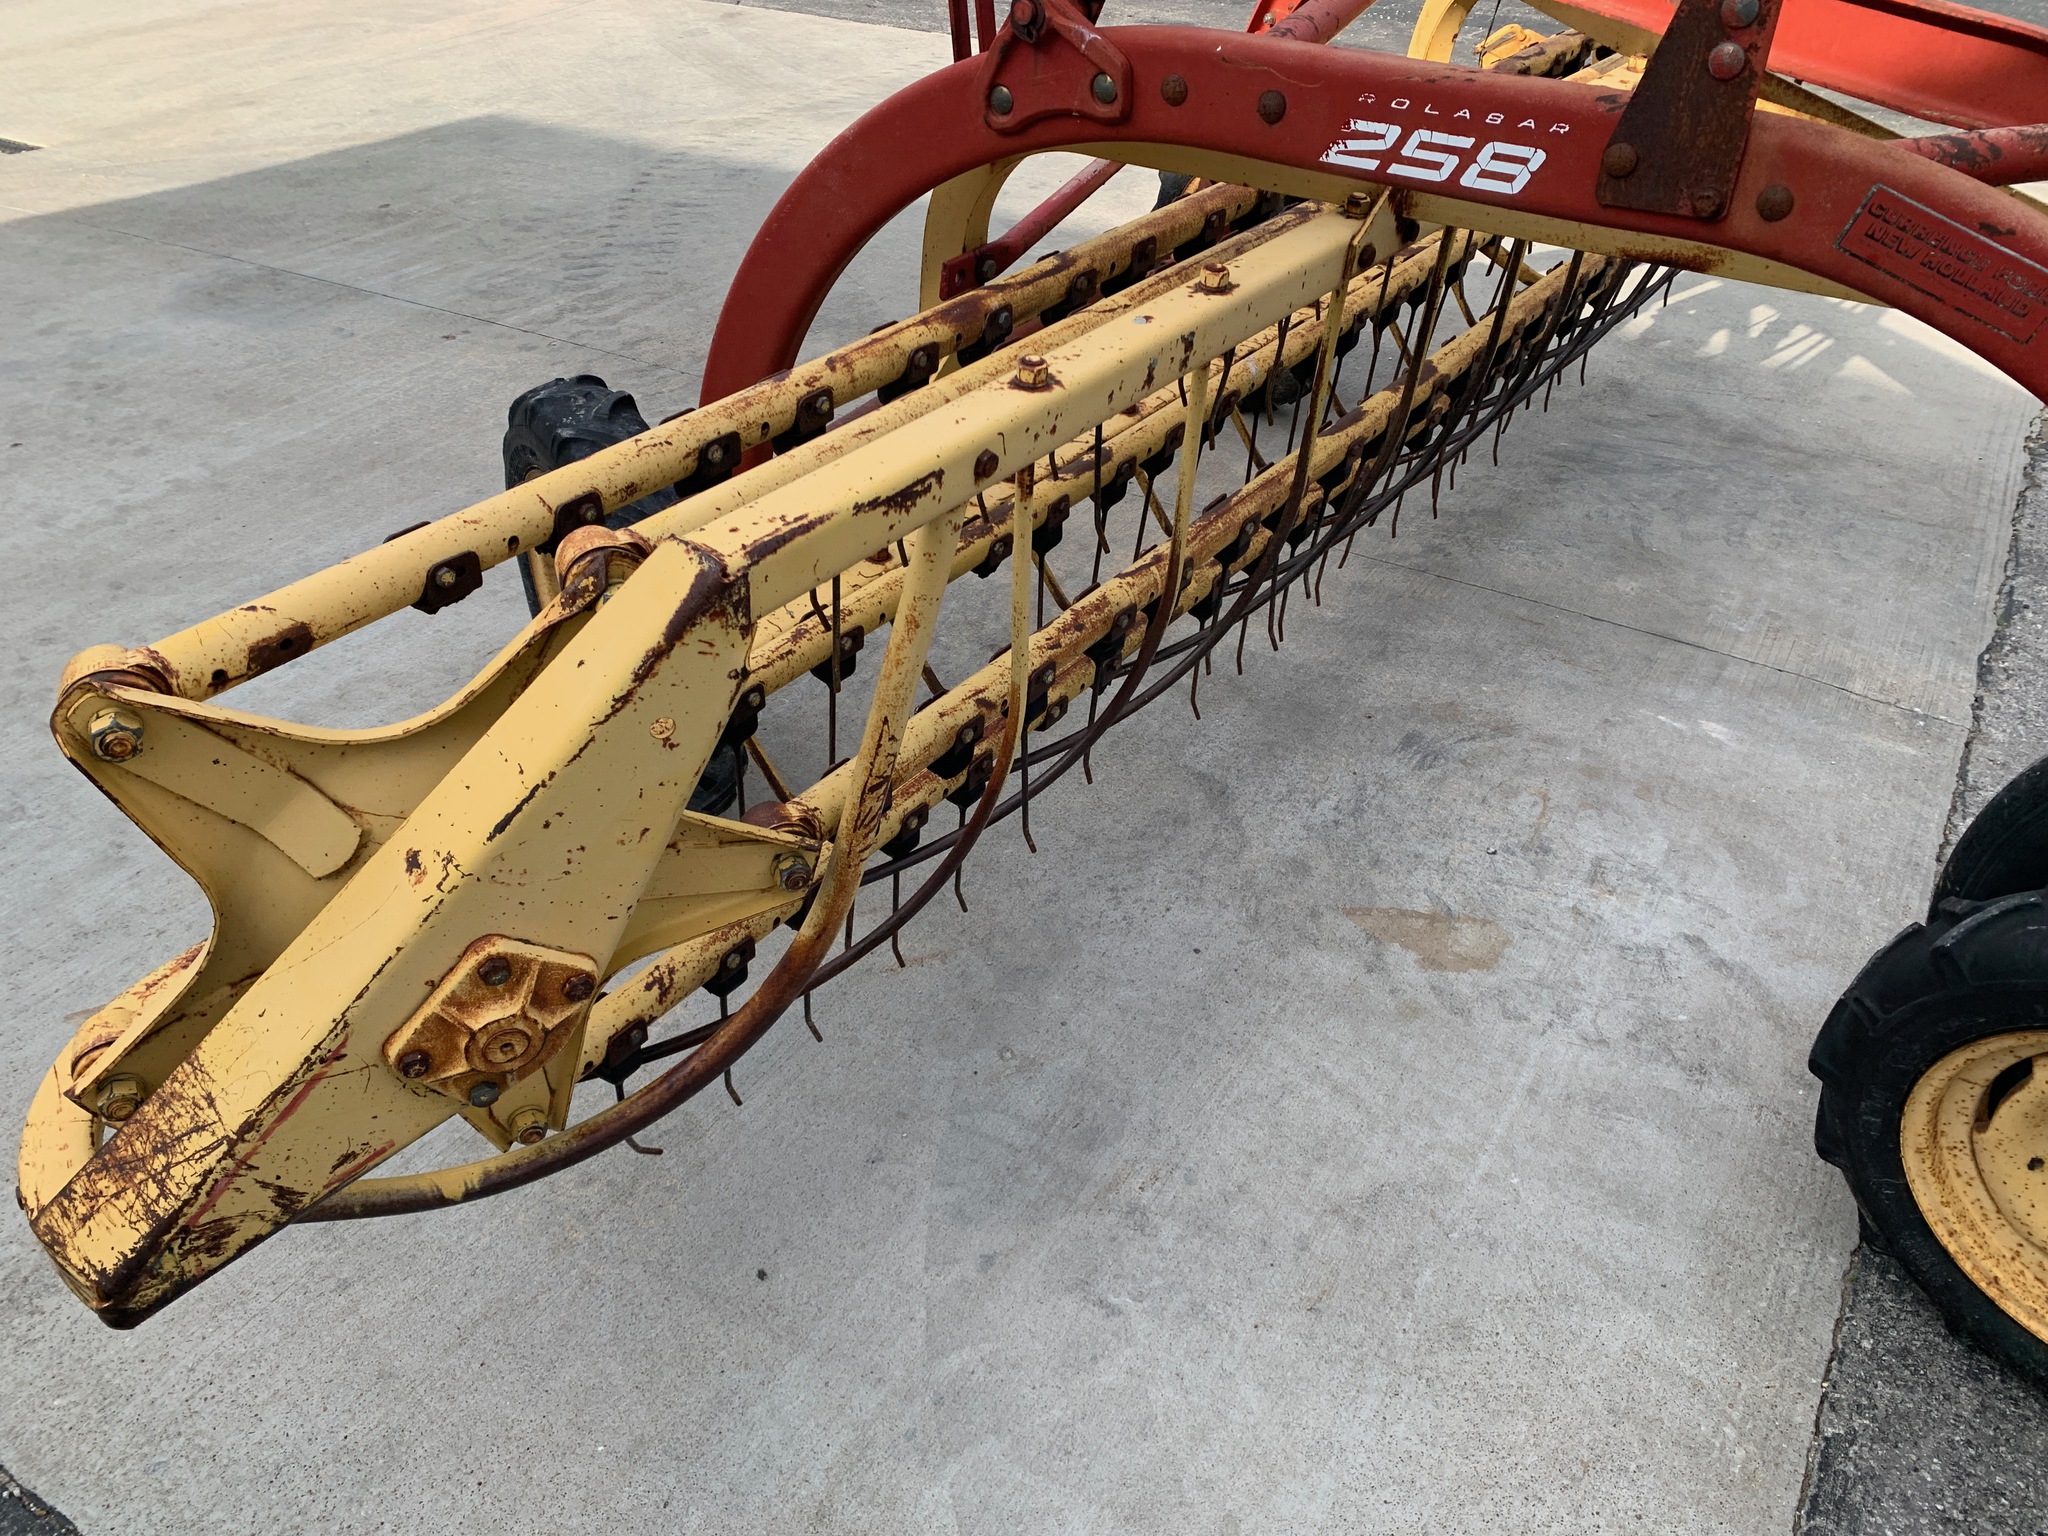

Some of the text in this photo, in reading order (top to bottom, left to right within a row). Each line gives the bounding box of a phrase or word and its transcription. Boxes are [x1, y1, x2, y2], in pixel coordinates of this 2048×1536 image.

[1358, 92, 1570, 134] ROLABAR
[1318, 118, 1547, 194] 258
[1864, 222, 2032, 319] NEW HOLLAND
